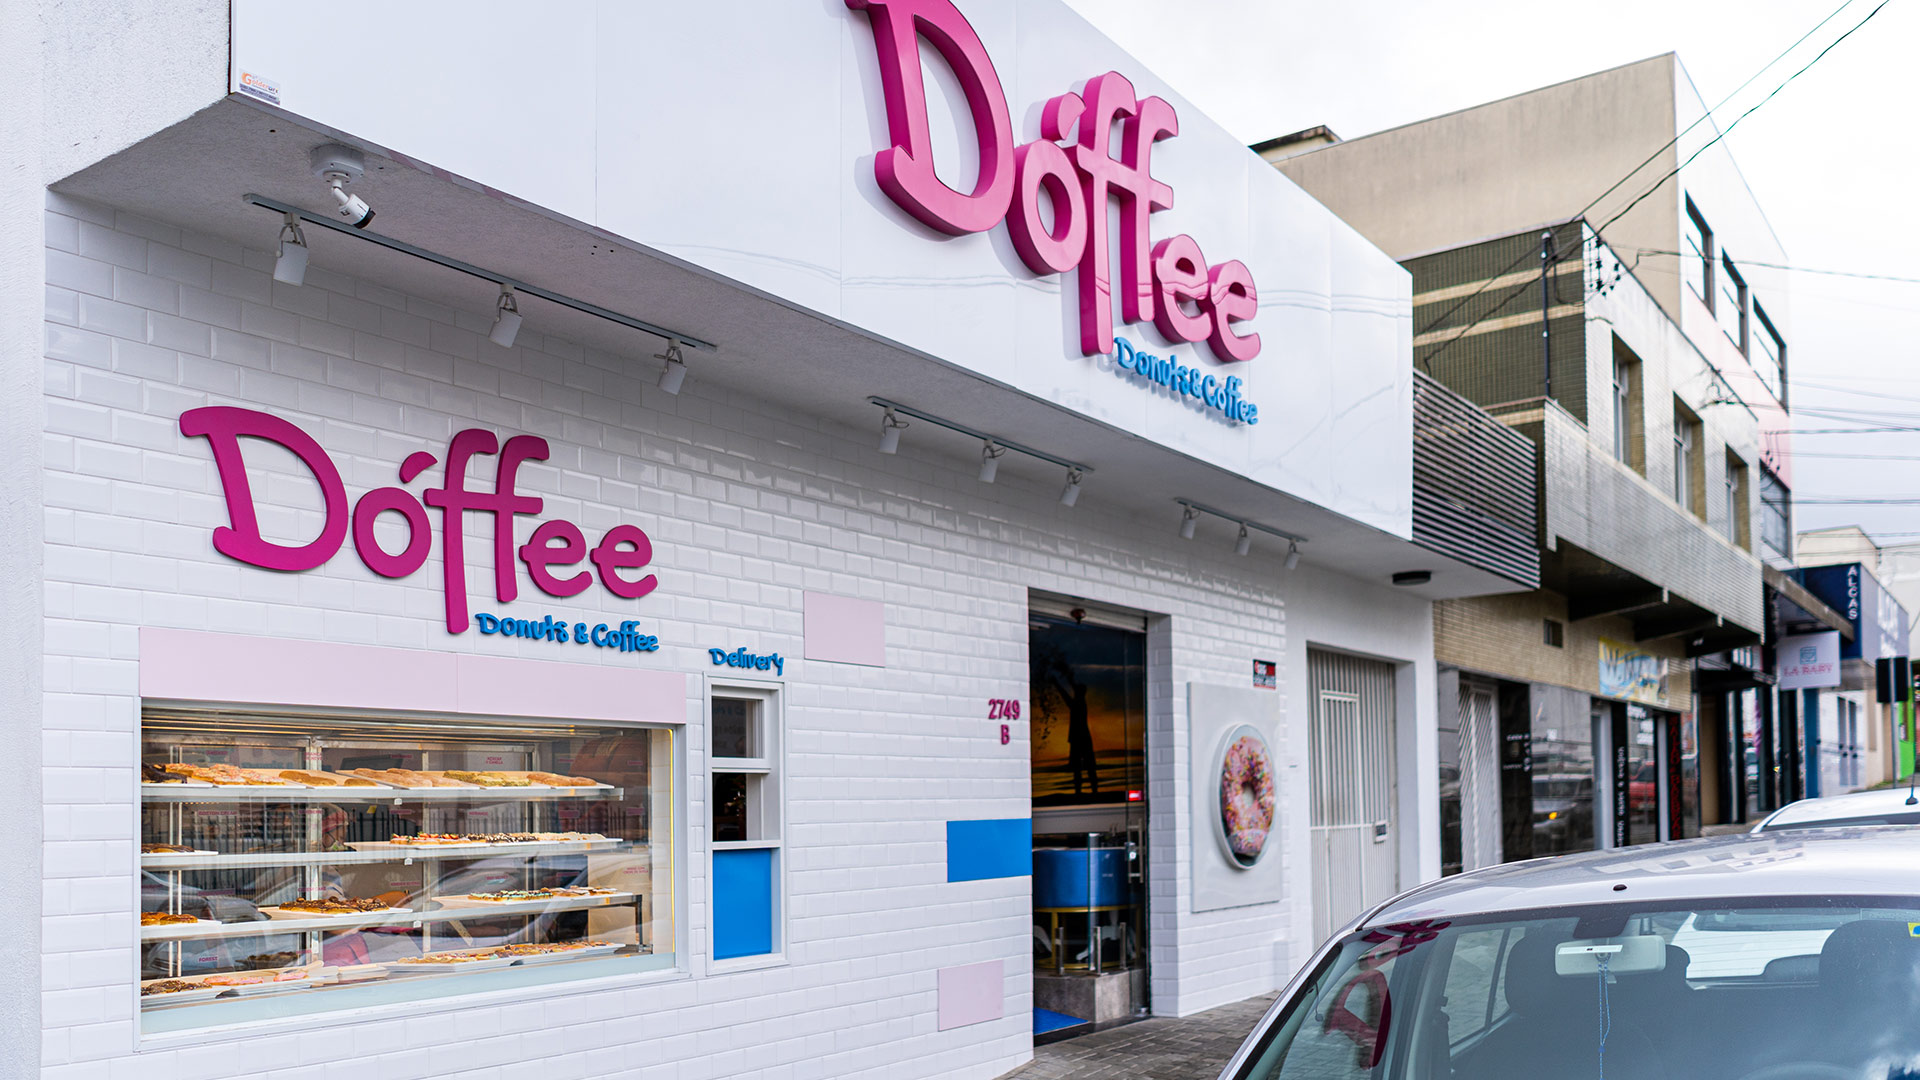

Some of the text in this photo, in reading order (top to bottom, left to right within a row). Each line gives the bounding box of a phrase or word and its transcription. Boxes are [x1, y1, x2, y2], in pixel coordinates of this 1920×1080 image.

[845, 0, 1261, 362] Dóffee
[1114, 337, 1259, 425] Donuts & Coffee
[179, 406, 658, 634] Dóffee
[475, 613, 660, 652] Donuts & Coffee
[708, 647, 784, 676] Delivery
[988, 698, 1020, 720] 2749
[1001, 724, 1011, 745] B
